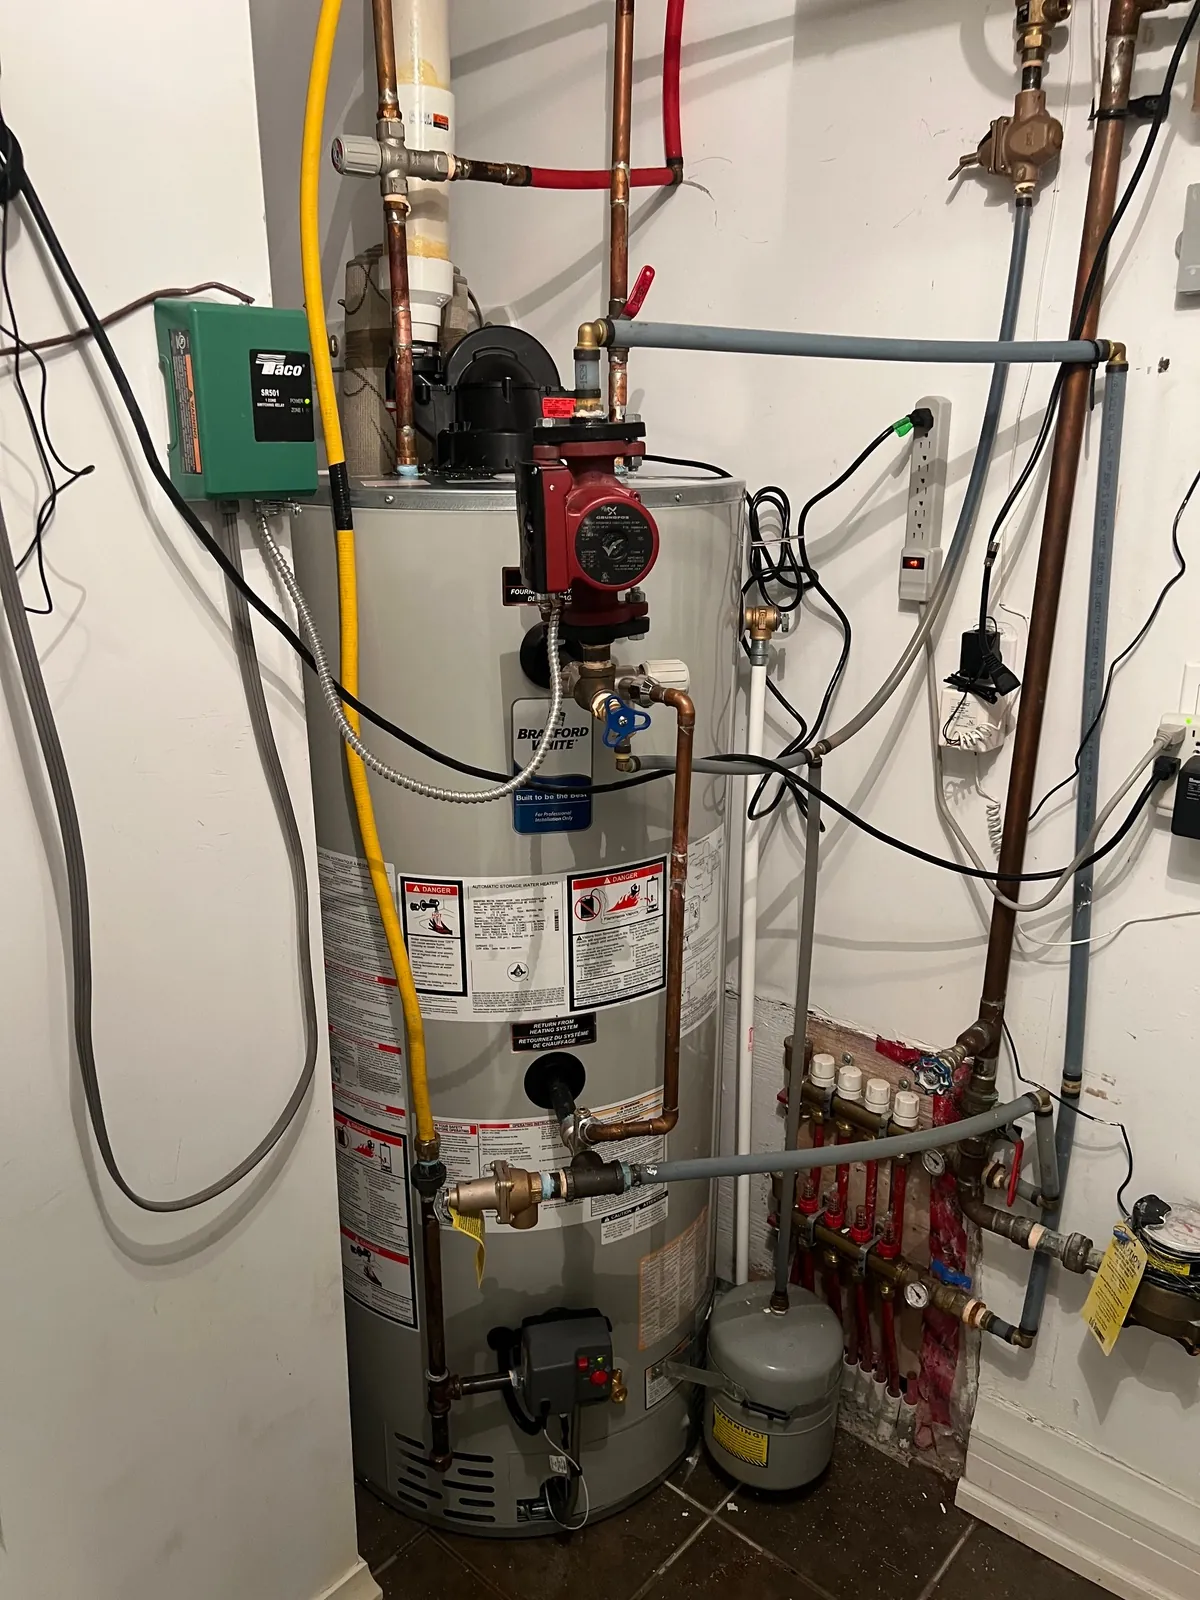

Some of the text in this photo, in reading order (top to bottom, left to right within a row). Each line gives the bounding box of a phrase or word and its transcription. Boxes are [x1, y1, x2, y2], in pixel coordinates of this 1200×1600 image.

[255, 353, 303, 376] Taco
[260, 388, 280, 397] SR501
[517, 727, 589, 740] BRAFORD
[612, 872, 638, 883] DANGER
[422, 886, 451, 894] DANGER
[542, 1038, 576, 1047] CHAUFFAGE
[611, 1209, 632, 1220] CAUTION
